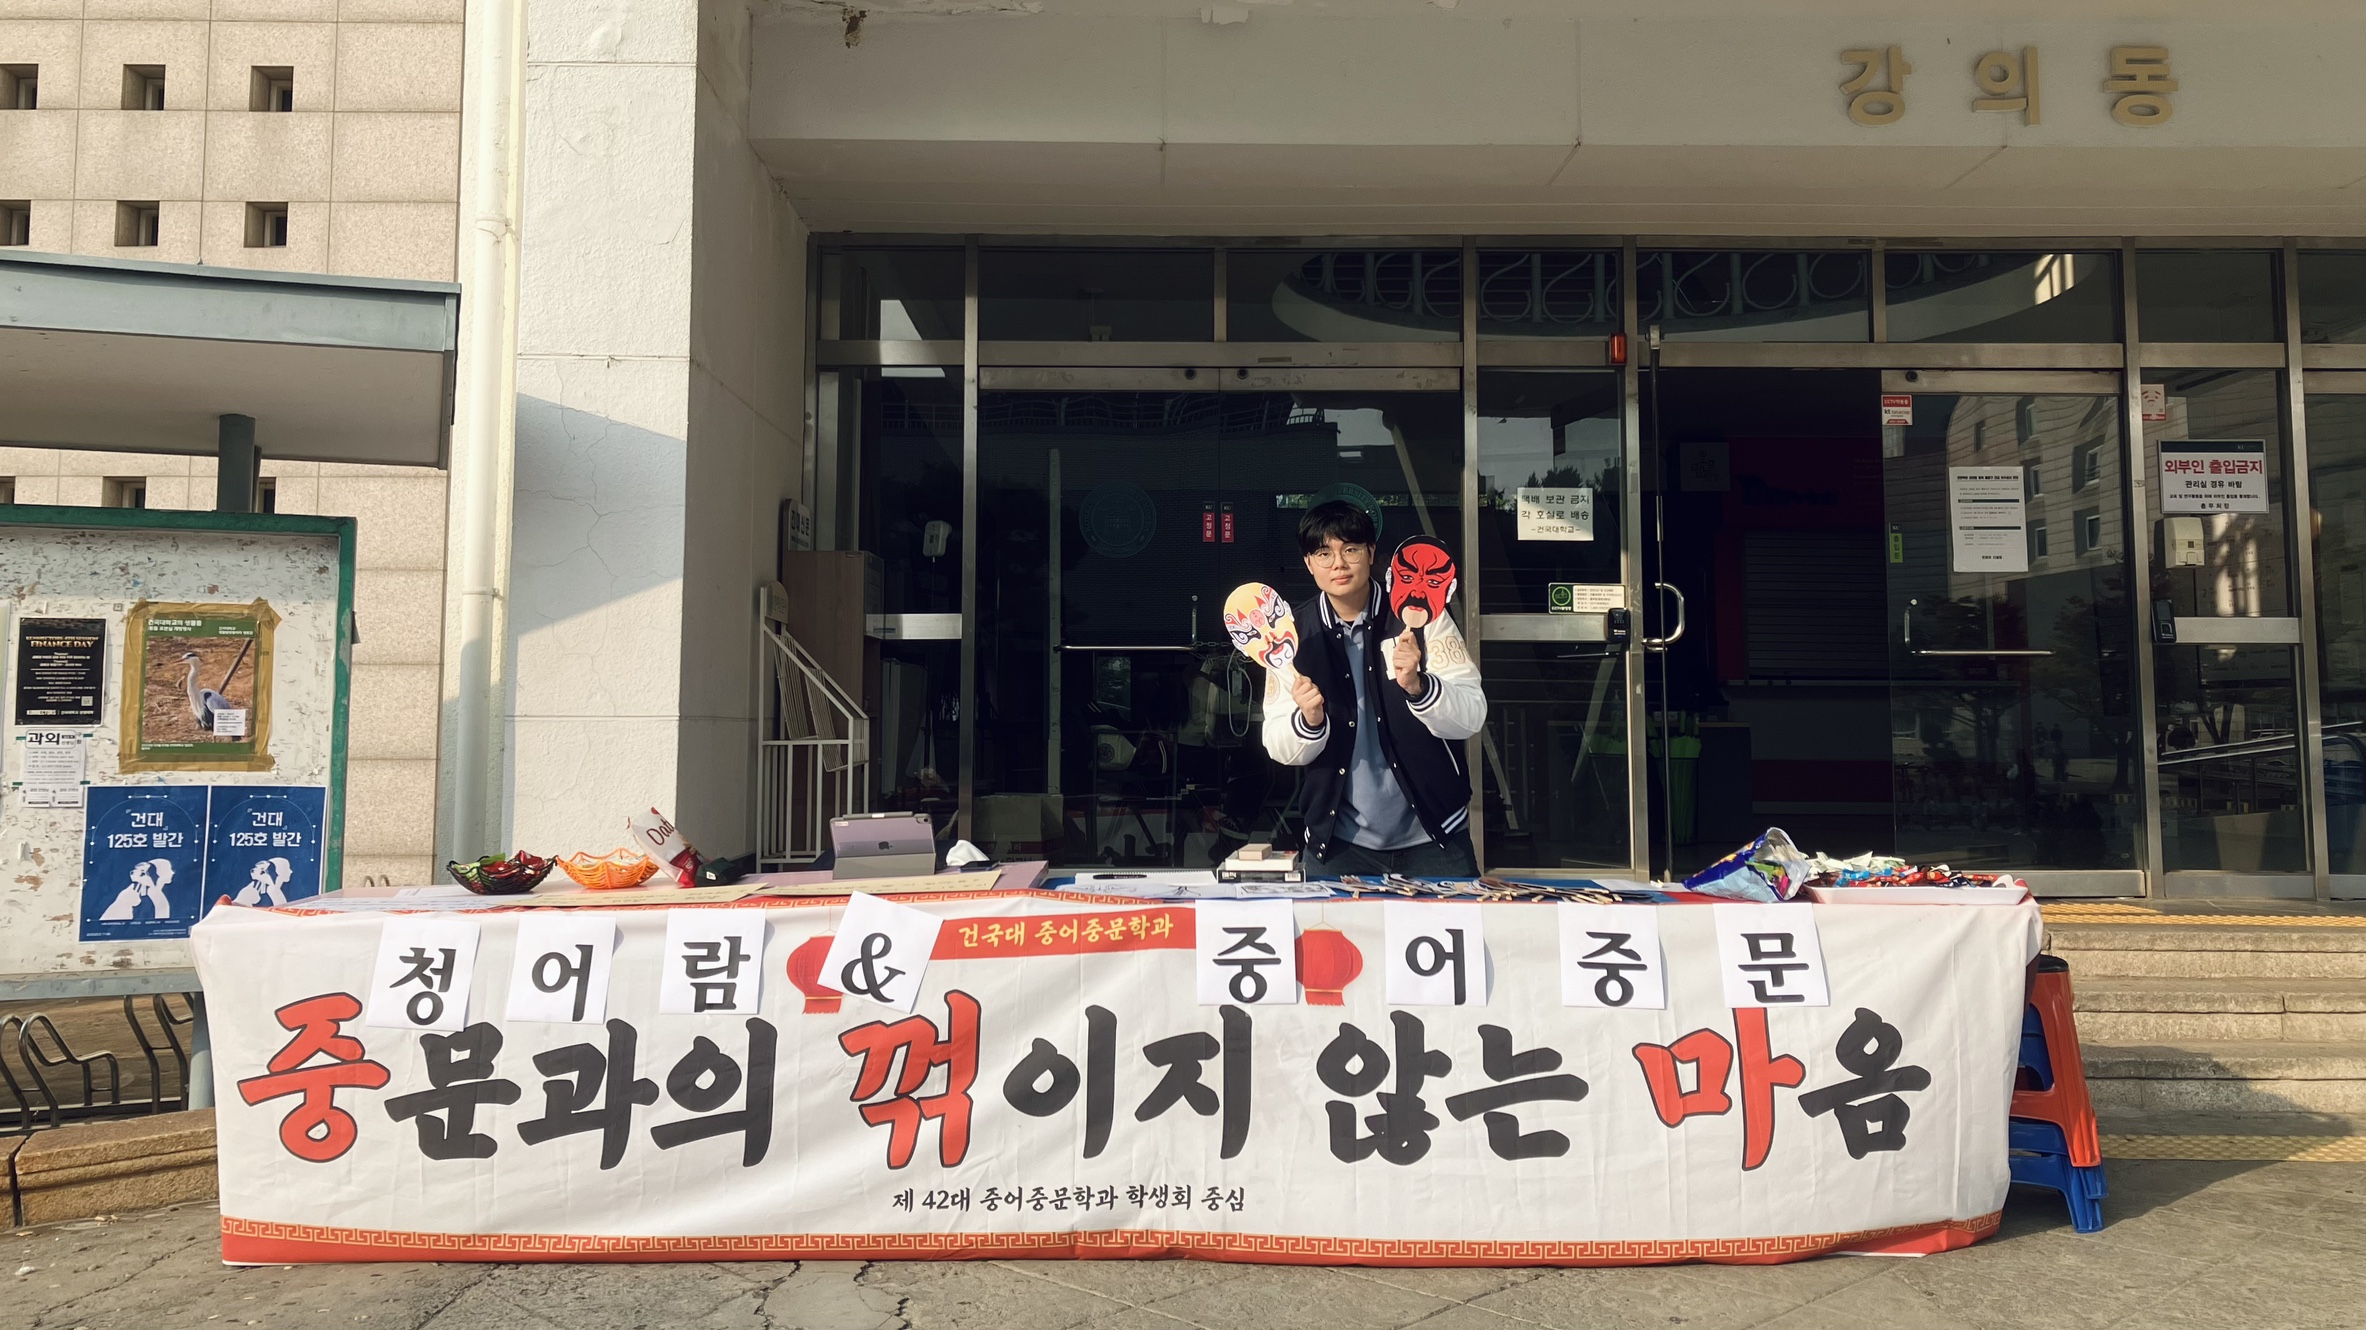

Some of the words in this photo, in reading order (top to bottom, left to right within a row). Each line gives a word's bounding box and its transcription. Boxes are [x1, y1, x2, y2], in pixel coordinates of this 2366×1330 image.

[1839, 45, 1911, 126] 강
[1972, 46, 2041, 127] 의
[2103, 45, 2179, 127] 동
[2164, 459, 2205, 475] 외부인
[2208, 459, 2263, 475] 출입금지
[2185, 480, 2207, 489] 관리실
[2210, 480, 2225, 489] 경유
[2228, 480, 2243, 489] 바람
[1545, 494, 1566, 504] 보관
[1570, 494, 1590, 505] 금지
[1521, 510, 1531, 520] 각
[1536, 510, 1566, 520] 호실로
[1570, 510, 1590, 521] 배송
[30, 640, 73, 648] FINANCE
[73, 640, 94, 648] DAY
[27, 732, 60, 746] 과외
[106, 833, 148, 849] 125호
[152, 832, 184, 849] 발간
[229, 832, 268, 847] 125호
[272, 831, 302, 848] 발간
[957, 919, 1027, 948] 건국대
[1033, 912, 1175, 947] 중어중문학과
[388, 945, 457, 1026] 청
[530, 942, 592, 1023] 어
[681, 935, 752, 1013] 람
[839, 931, 908, 1003] &
[1211, 926, 1283, 1004] 중
[1404, 926, 1466, 1006] 어
[1576, 931, 1649, 1008] 중
[1736, 932, 1810, 1005] 문
[236, 992, 778, 1170] 중문과의
[838, 988, 1253, 1170] 꺾이지
[1316, 1009, 1590, 1166] 않는
[1631, 1006, 1932, 1171] 마음
[892, 1187, 914, 1213] 제
[921, 1187, 972, 1213] 42대
[979, 1184, 1119, 1213] 중어중문학과
[1125, 1183, 1193, 1212] 학생회
[1200, 1185, 1246, 1213] 중심
